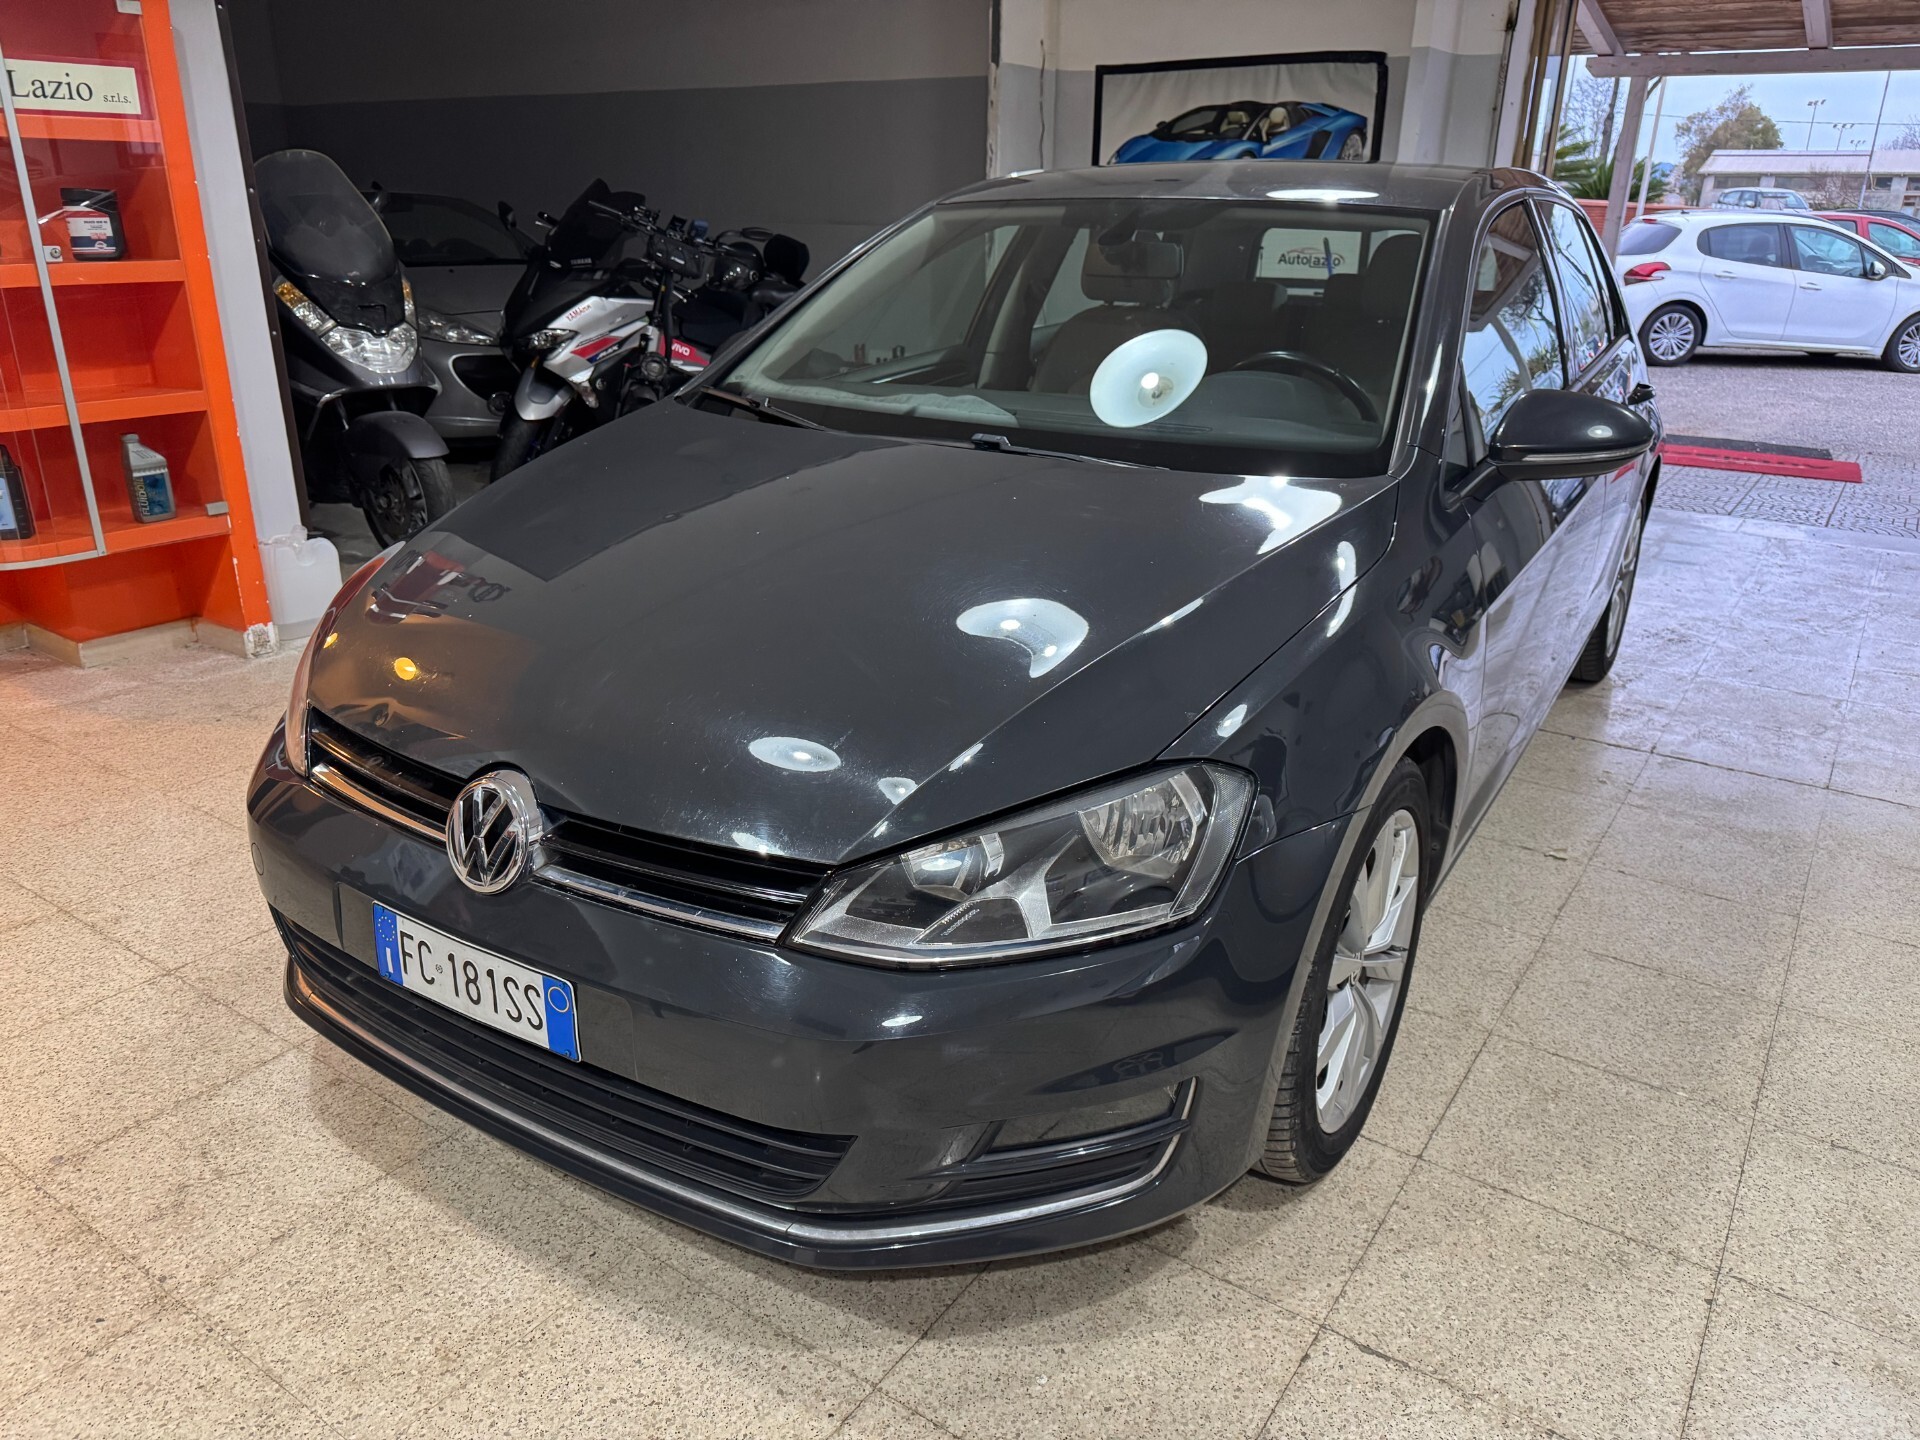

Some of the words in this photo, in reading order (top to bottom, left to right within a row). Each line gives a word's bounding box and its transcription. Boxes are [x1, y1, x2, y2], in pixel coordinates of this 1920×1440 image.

[6, 69, 93, 101] Lazio
[400, 930, 435, 986] FC
[447, 953, 544, 1031] 181SS
